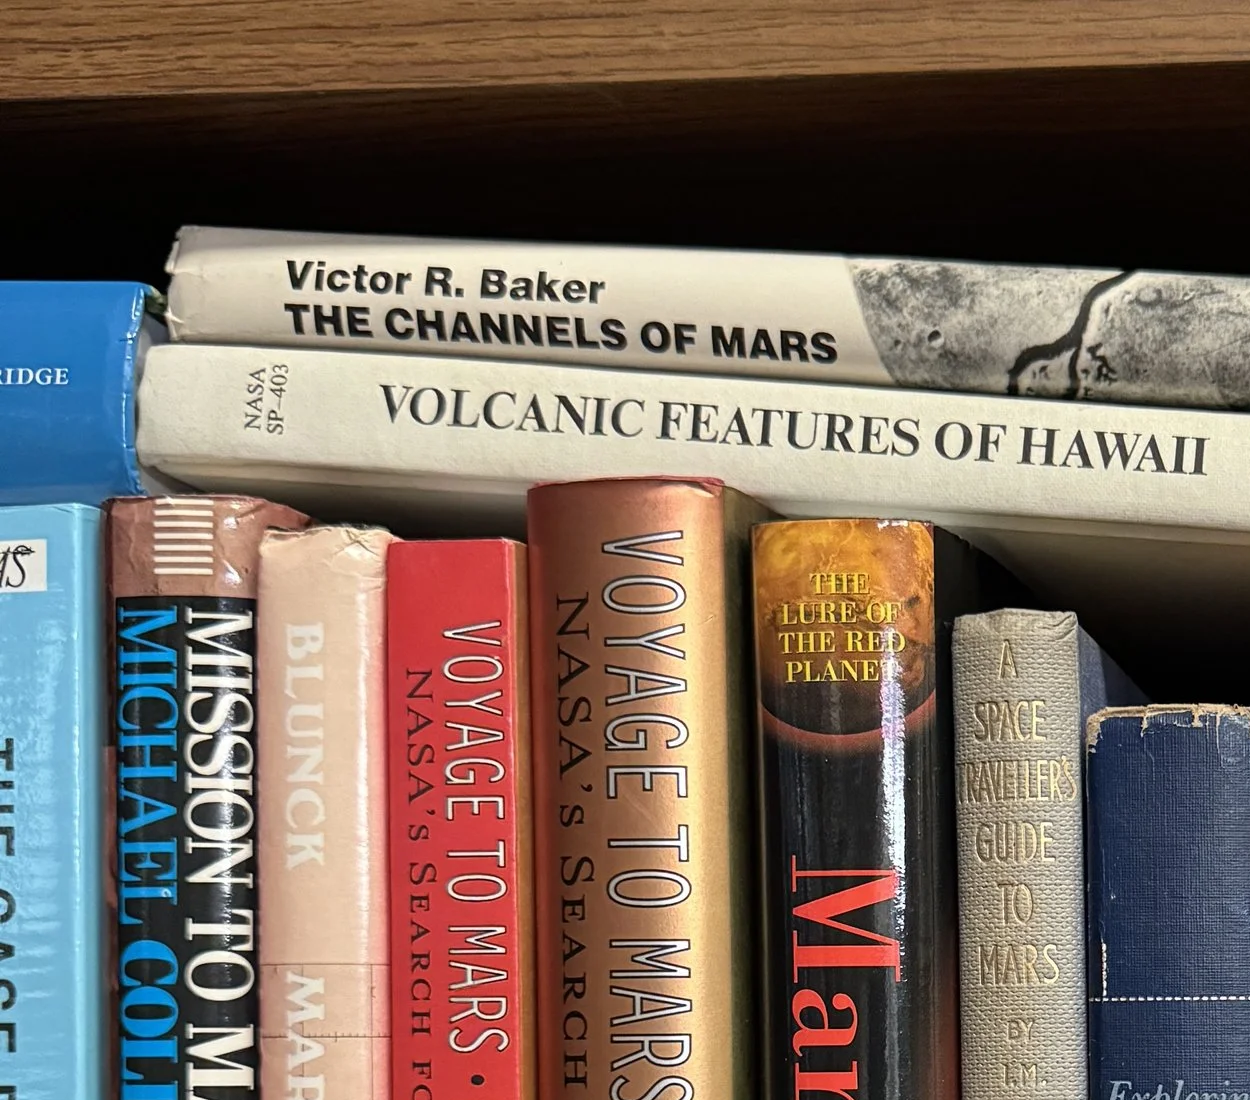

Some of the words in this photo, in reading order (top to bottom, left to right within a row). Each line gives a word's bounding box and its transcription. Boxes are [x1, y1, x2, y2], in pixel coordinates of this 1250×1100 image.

[285, 260, 412, 298] Victor
[423, 267, 464, 299] R.
[479, 268, 606, 305] Baker
[283, 303, 372, 340] THE
[385, 307, 628, 352] CHANNELS
[640, 321, 697, 355] OF
[711, 326, 838, 365] MARS
[244, 366, 268, 433] NASA
[379, 382, 645, 438] VOLCANIC
[656, 400, 917, 459] FEATURES
[934, 421, 1007, 465] OF
[1017, 425, 1209, 478] HAWAII
[810, 573, 870, 595] THE
[781, 602, 857, 625] LURE
[867, 601, 901, 624] OF
[601, 529, 690, 800] VOYAGE
[779, 631, 835, 654] THE
[845, 631, 906, 652] RED
[999, 639, 1018, 678] A
[785, 660, 900, 682] PLANET
[184, 606, 254, 889] MISSION
[284, 622, 325, 871] BLUNCK
[441, 621, 505, 822] VOYAGE
[973, 700, 1048, 741] SPACE
[116, 606, 179, 926] MICHAEL
[956, 755, 1078, 803] TRAVELLER'S
[606, 824, 691, 909] TO
[975, 822, 1056, 864] GUIDE
[446, 841, 506, 902] TO
[998, 883, 1034, 926] TO
[184, 909, 255, 1001] TO
[979, 943, 1060, 987] MARS
[447, 924, 510, 1054] MARS
[1006, 1020, 1034, 1040] BY
